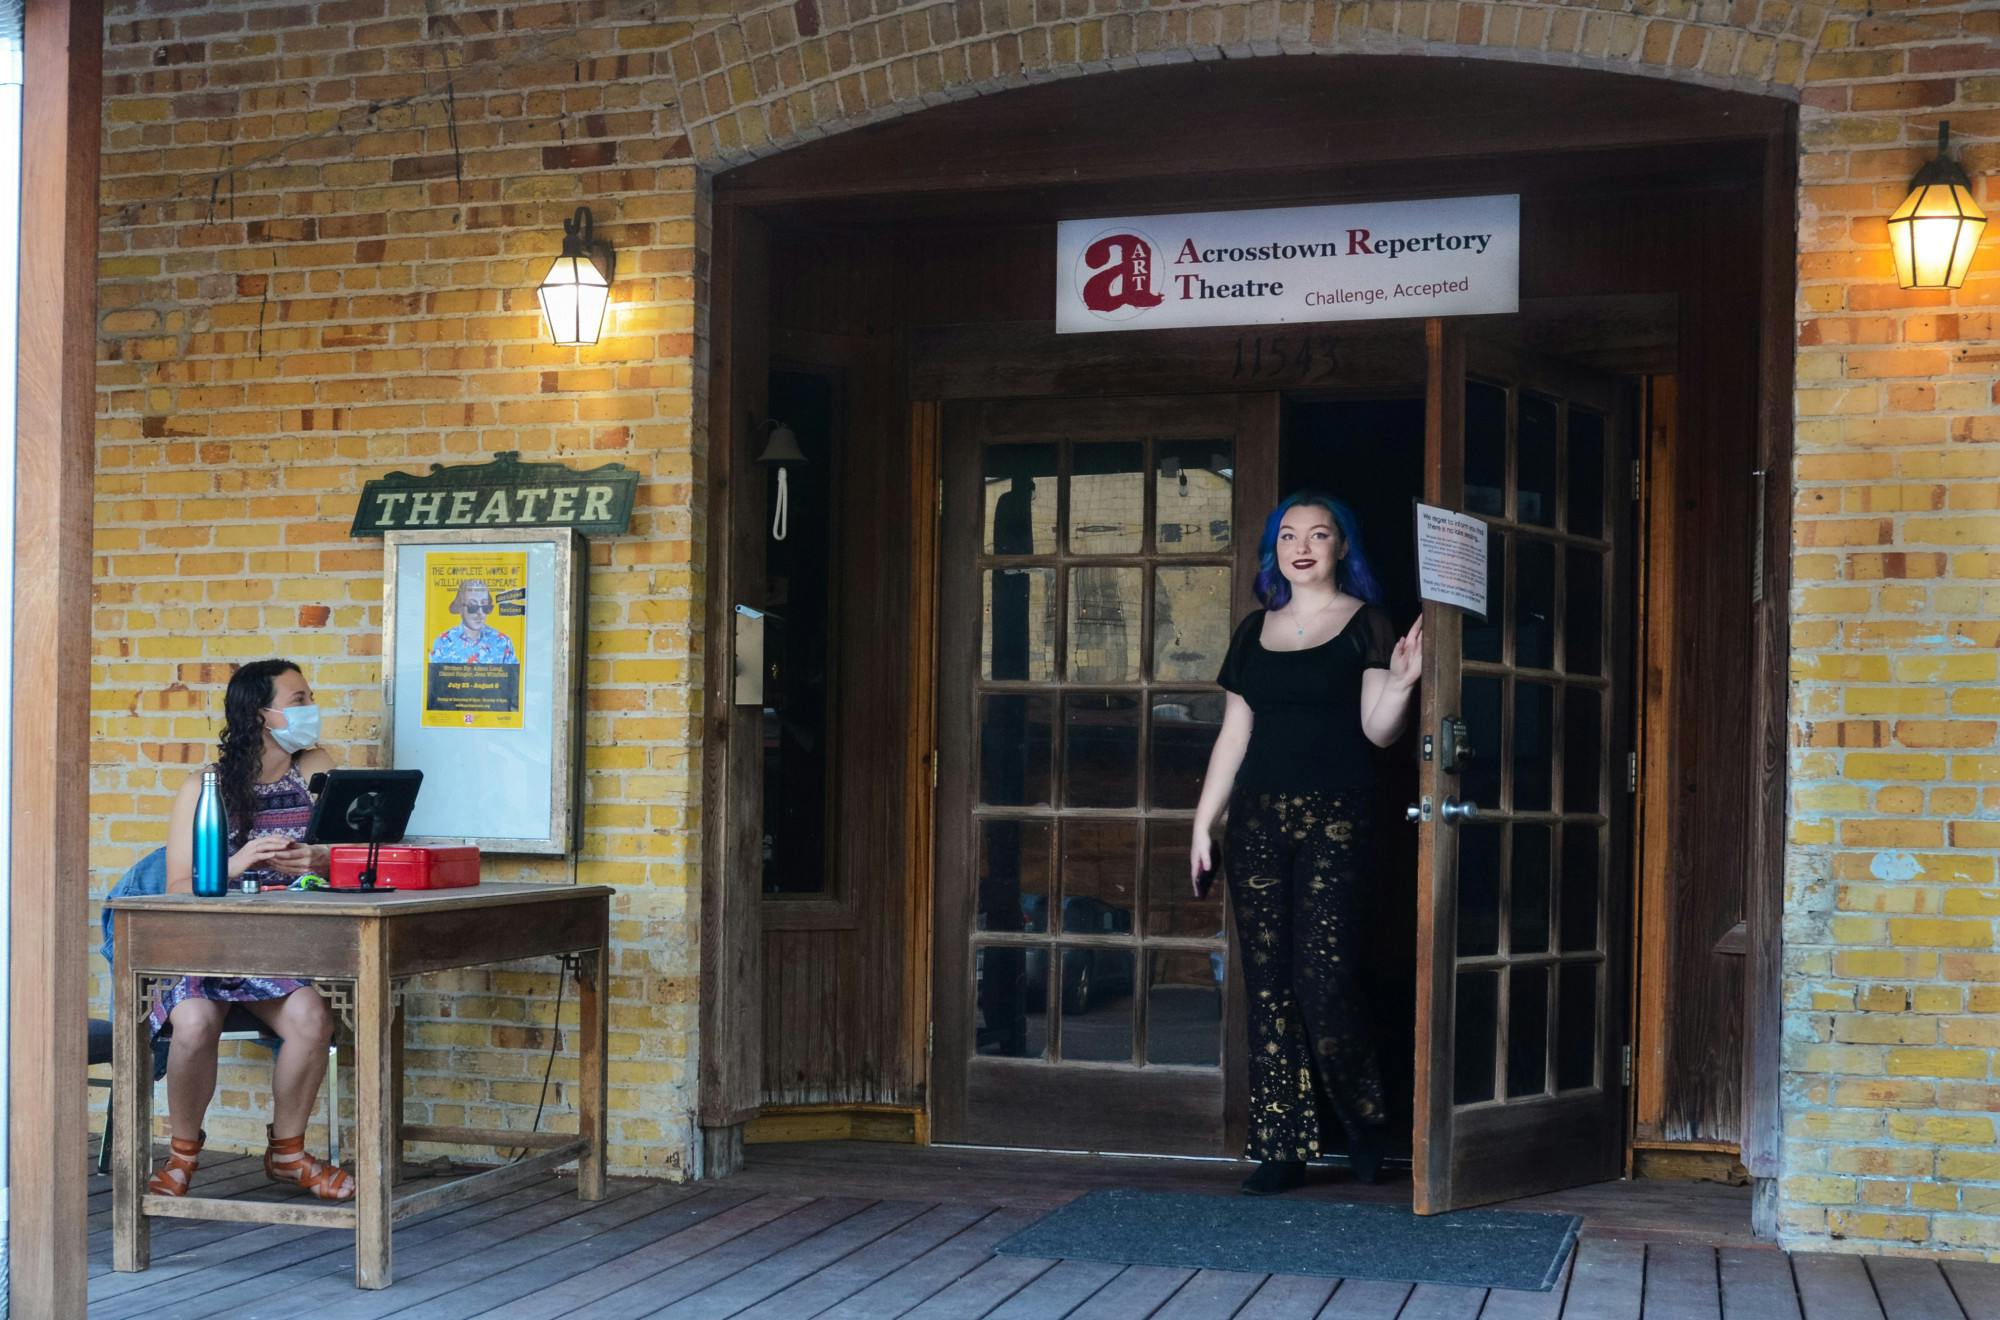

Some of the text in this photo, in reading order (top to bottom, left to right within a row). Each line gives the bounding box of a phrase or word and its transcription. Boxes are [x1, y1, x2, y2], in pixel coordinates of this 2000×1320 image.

[1174, 228, 1492, 265] Acrosstown Repertory
[1131, 243, 1148, 291] ART
[1174, 274, 1284, 300] Theatre
[1305, 276, 1469, 306] Challenge, Accepted
[1232, 335, 1339, 383] 11543
[375, 486, 614, 526] THEATER
[432, 567, 445, 576] THE
[447, 567, 483, 576] COMPLETE
[486, 567, 508, 576] WORKS
[448, 682, 461, 690] July
[474, 682, 494, 690] August
